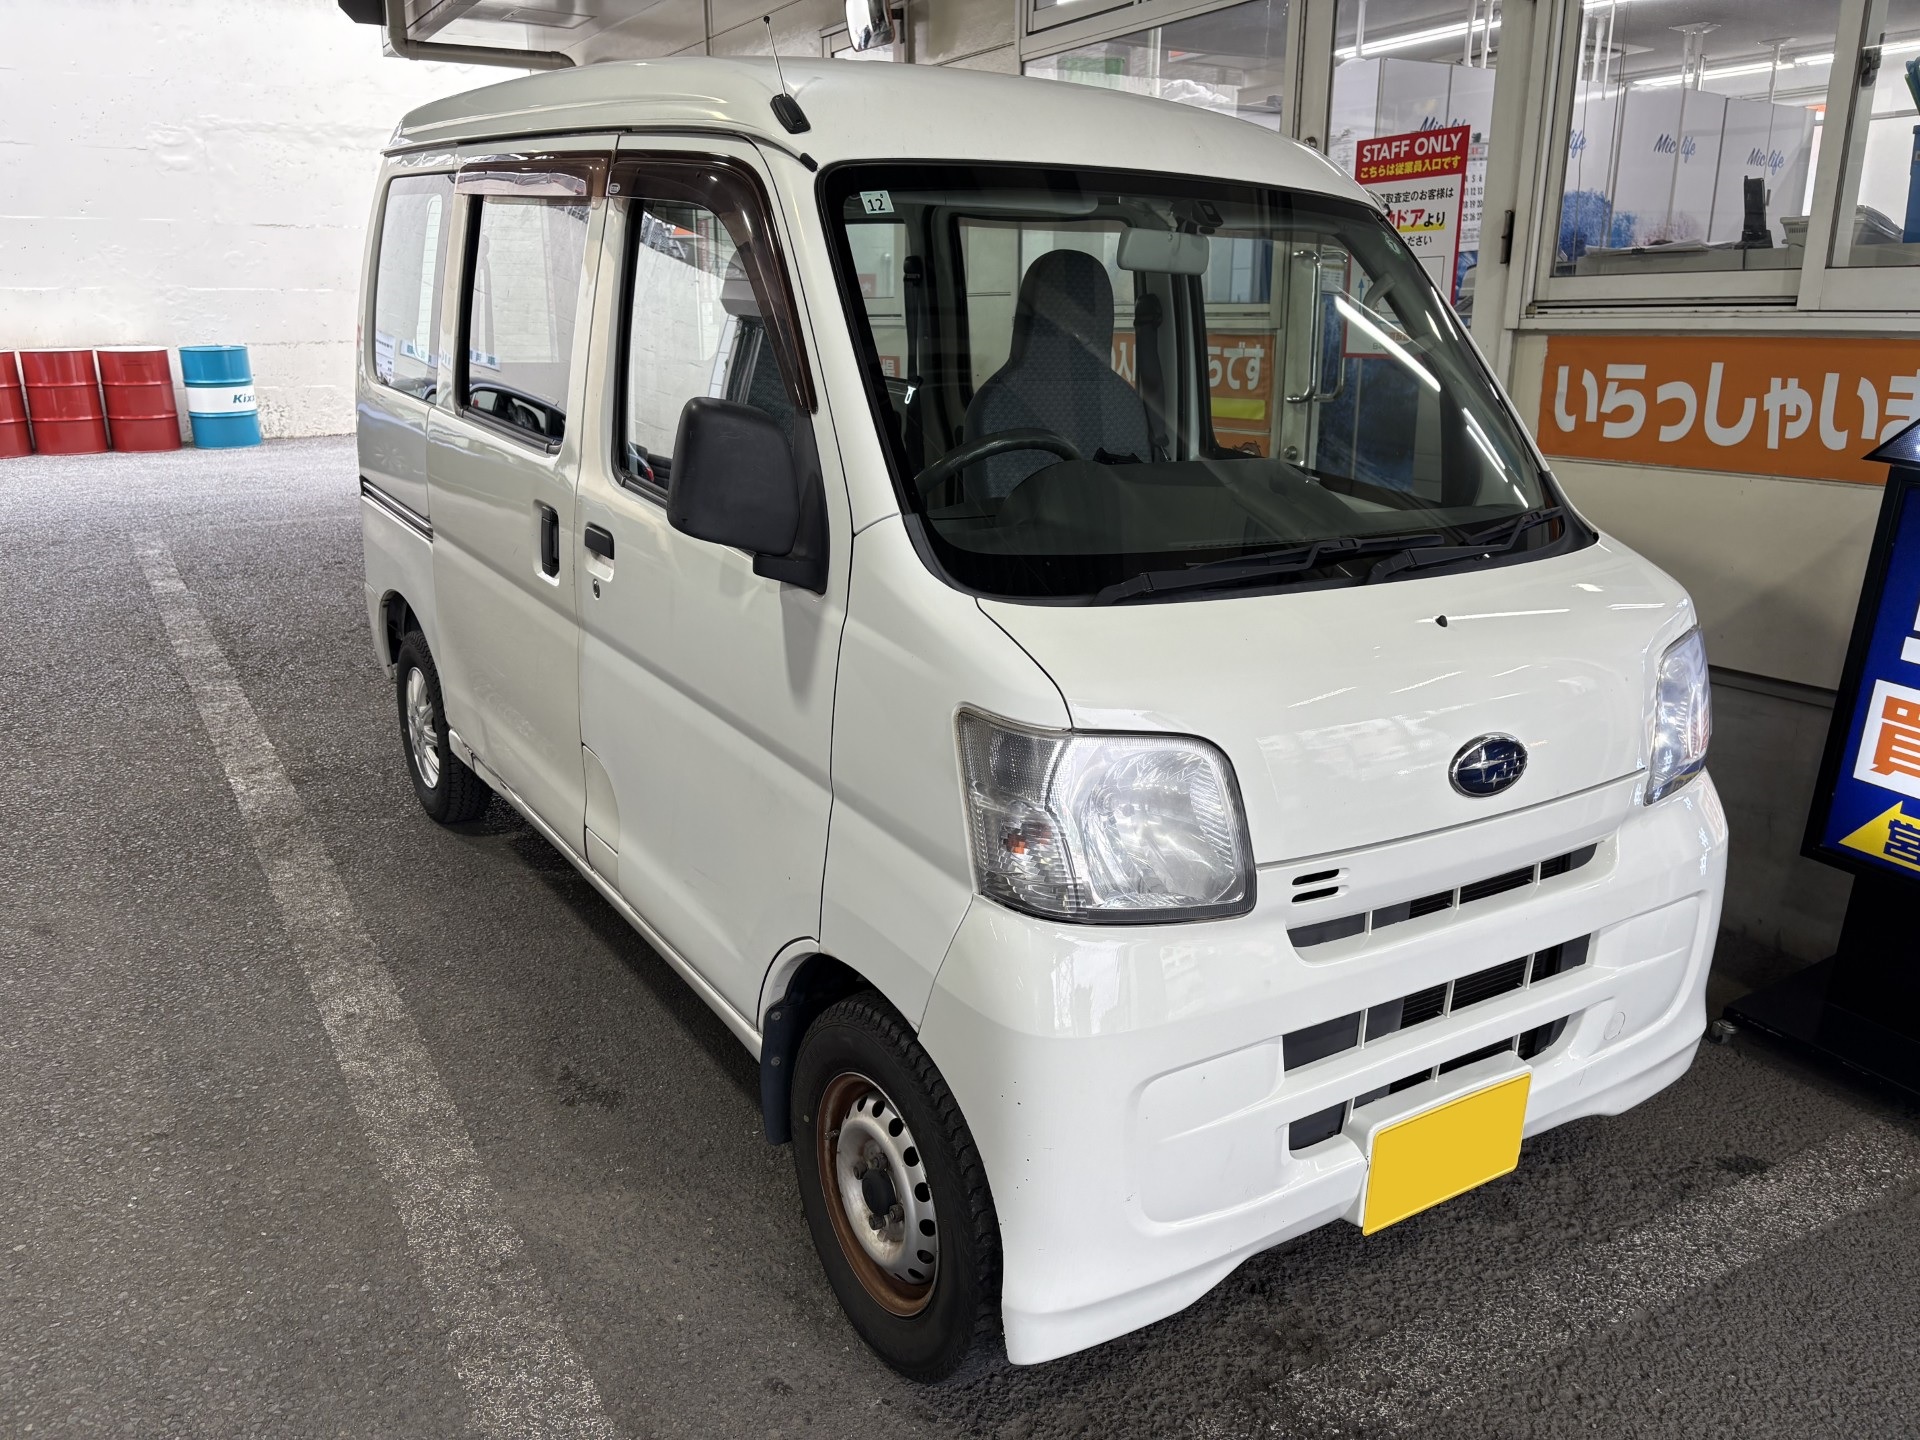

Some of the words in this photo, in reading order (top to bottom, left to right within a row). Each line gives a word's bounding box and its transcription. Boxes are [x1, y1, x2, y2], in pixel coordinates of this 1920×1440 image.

[1362, 140, 1410, 163] STAFF
[1414, 132, 1462, 155] ONLY
[1360, 155, 1461, 179] こちらは従業員入口です
[867, 198, 886, 212] 12
[1403, 235, 1432, 247] ださい
